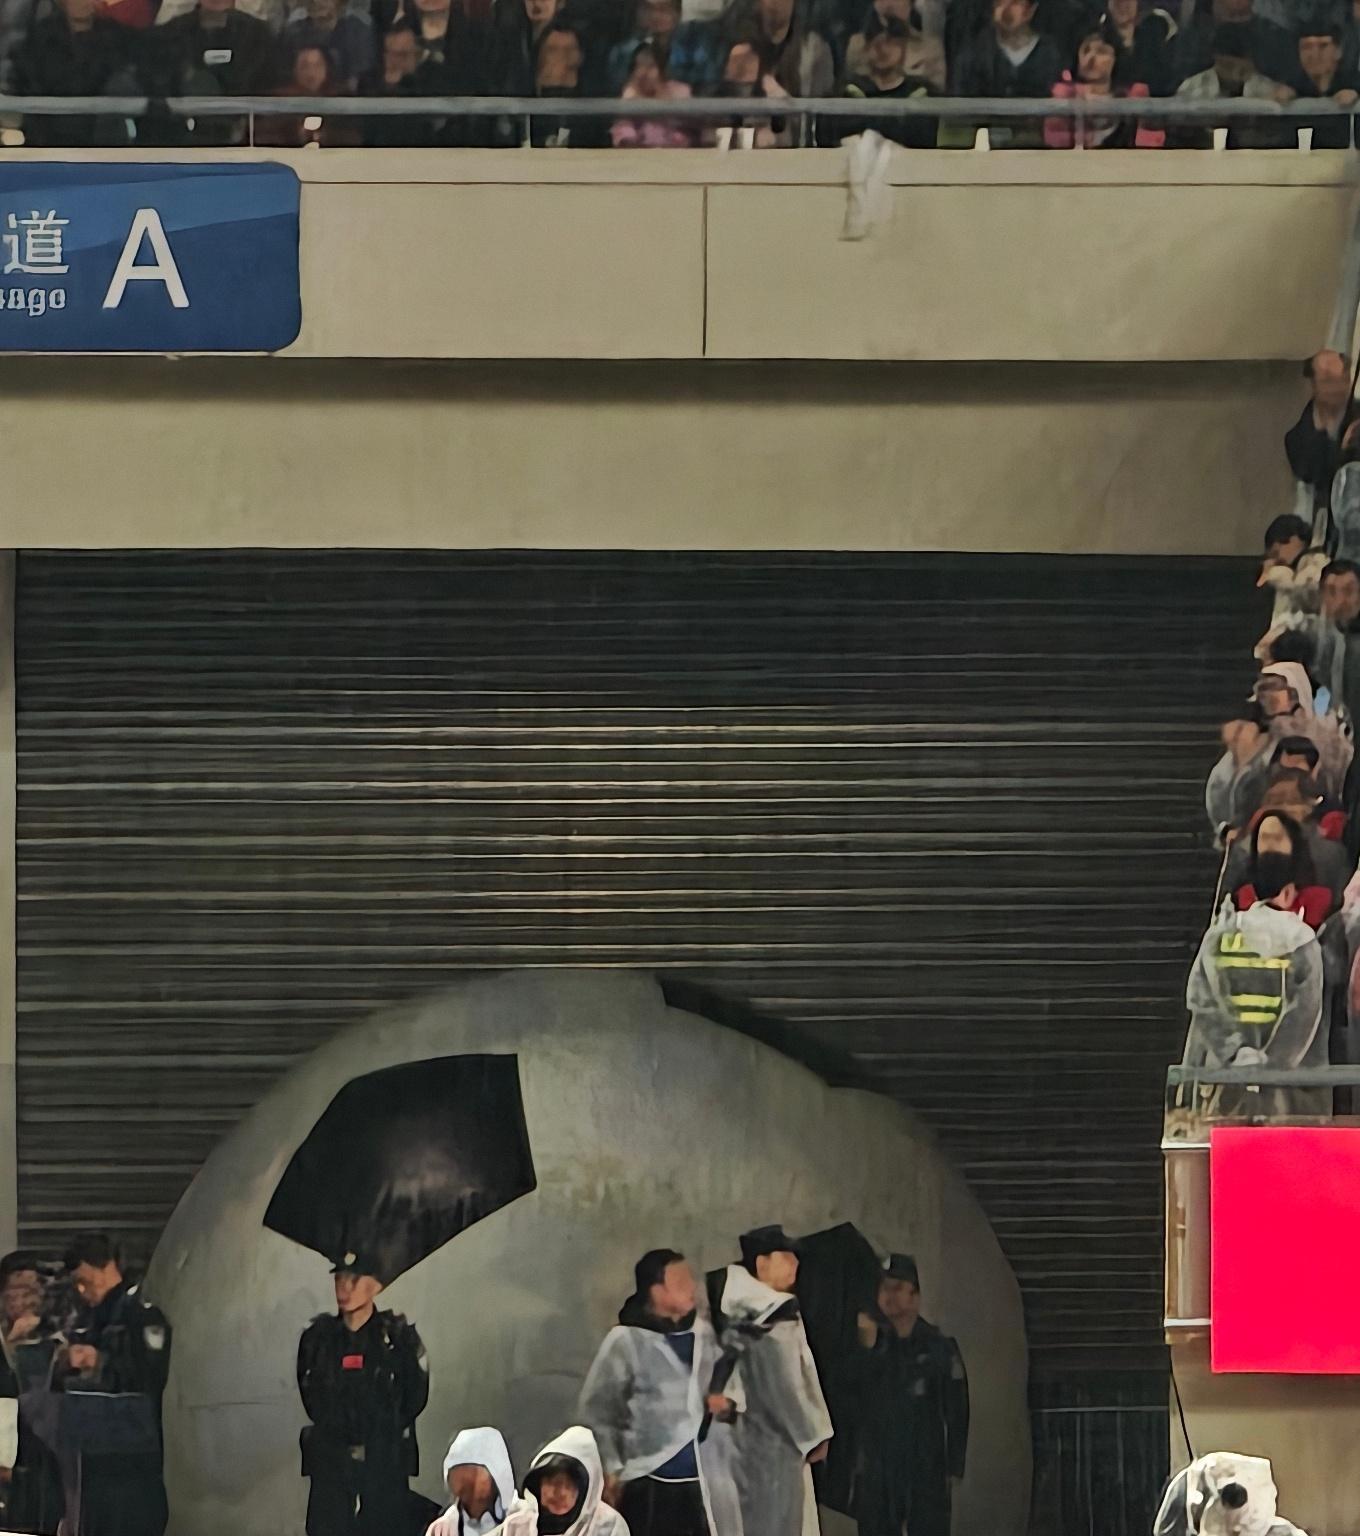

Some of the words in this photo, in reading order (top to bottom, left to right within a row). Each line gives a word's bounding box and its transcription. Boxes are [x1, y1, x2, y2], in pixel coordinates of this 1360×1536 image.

[3, 209, 70, 275] 道
[102, 207, 190, 309] A
[0, 288, 67, 317] ago
